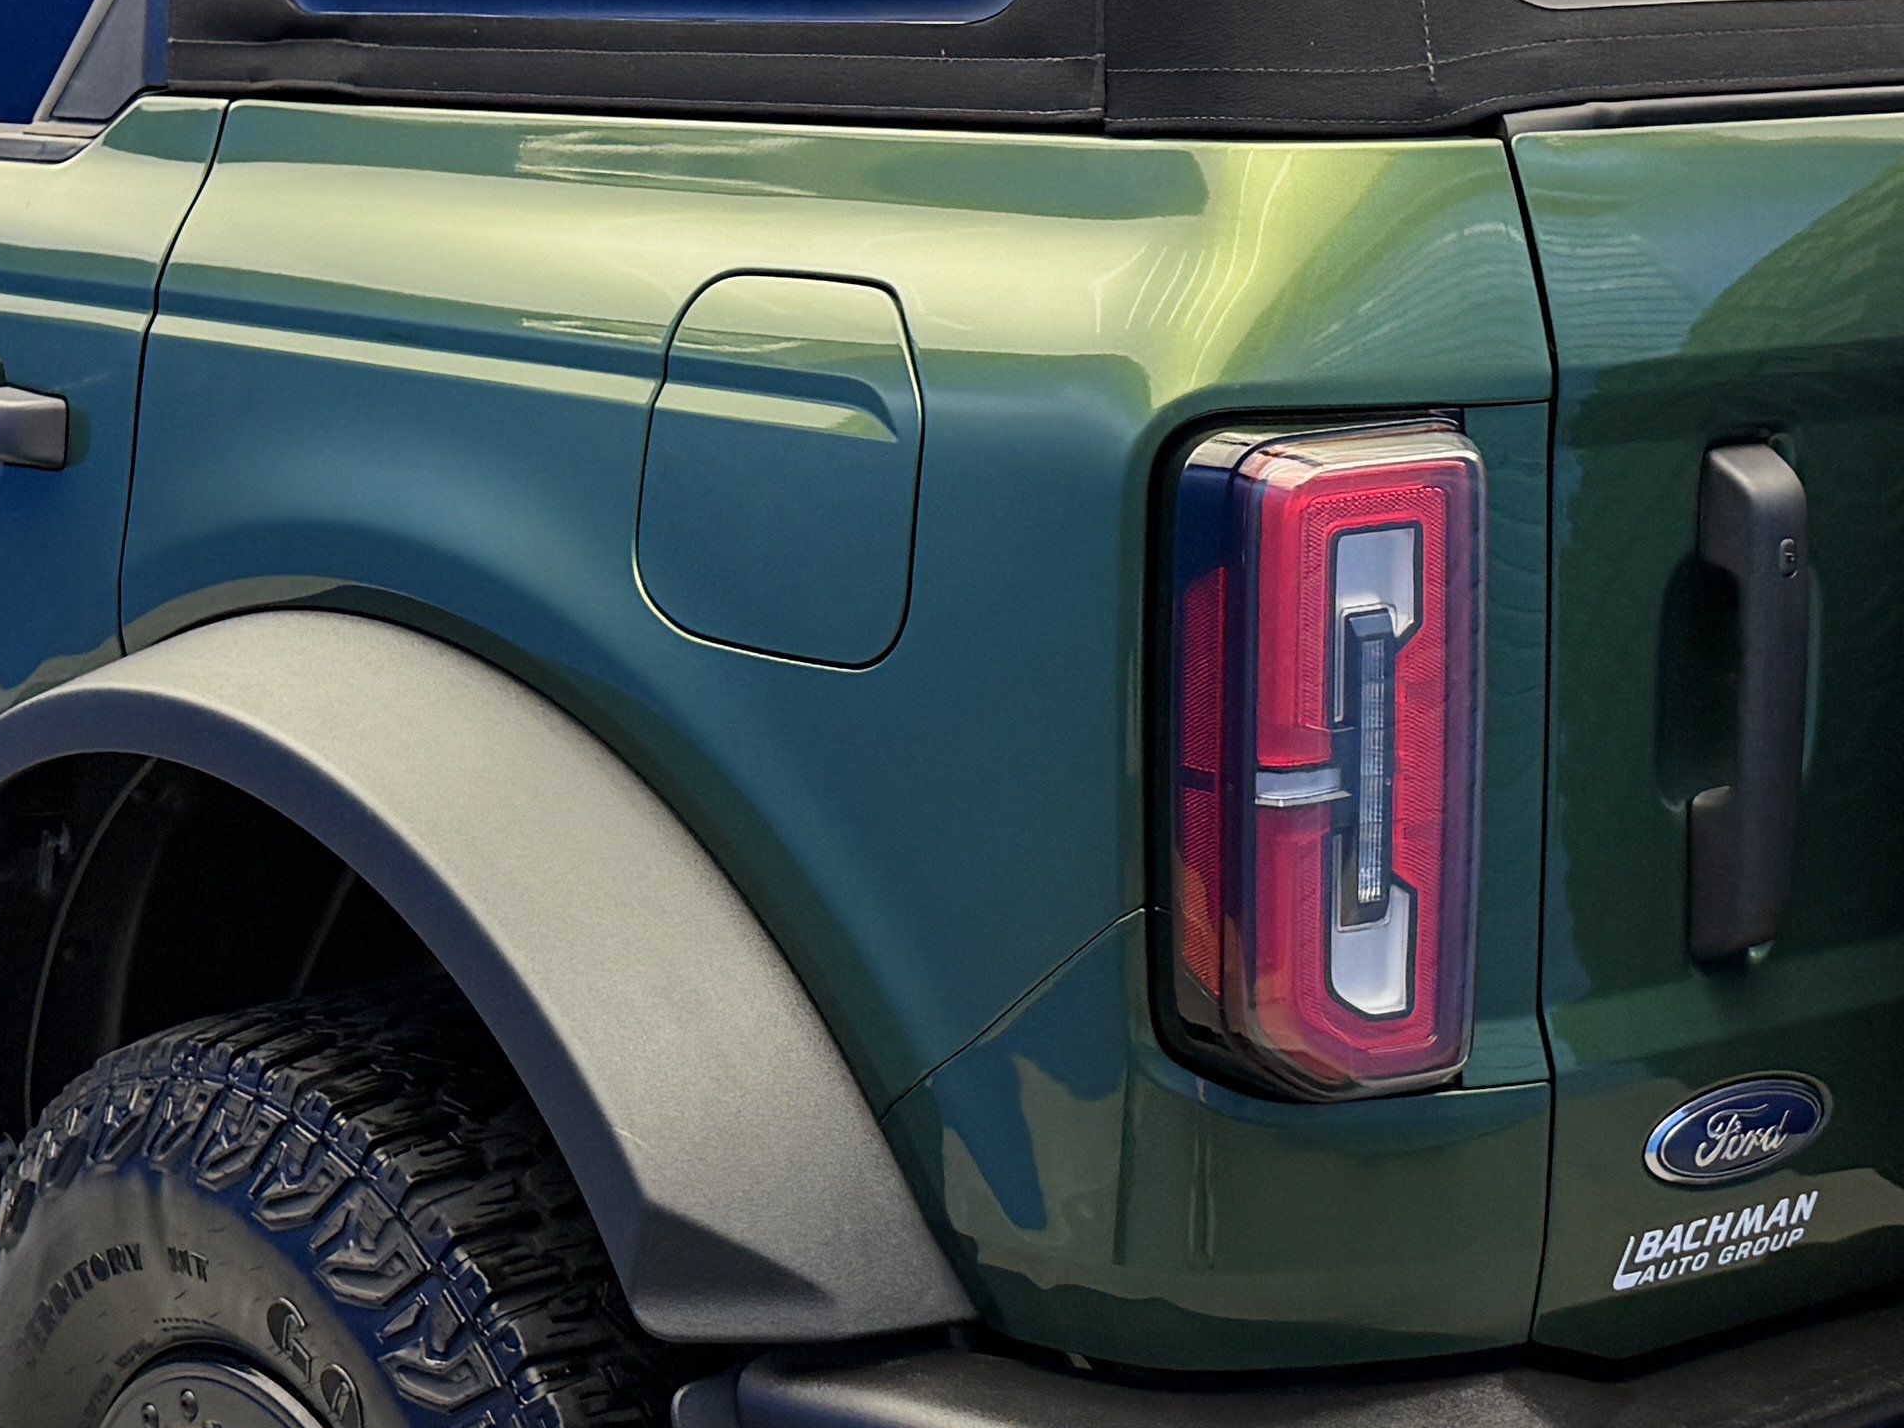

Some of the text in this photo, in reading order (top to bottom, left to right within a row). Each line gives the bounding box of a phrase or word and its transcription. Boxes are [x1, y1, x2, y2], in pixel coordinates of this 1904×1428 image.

[1695, 1103, 1792, 1168] Ford
[1633, 1190, 1819, 1264] BACHMAN
[1637, 1227, 1805, 1286] AUTO GROUP
